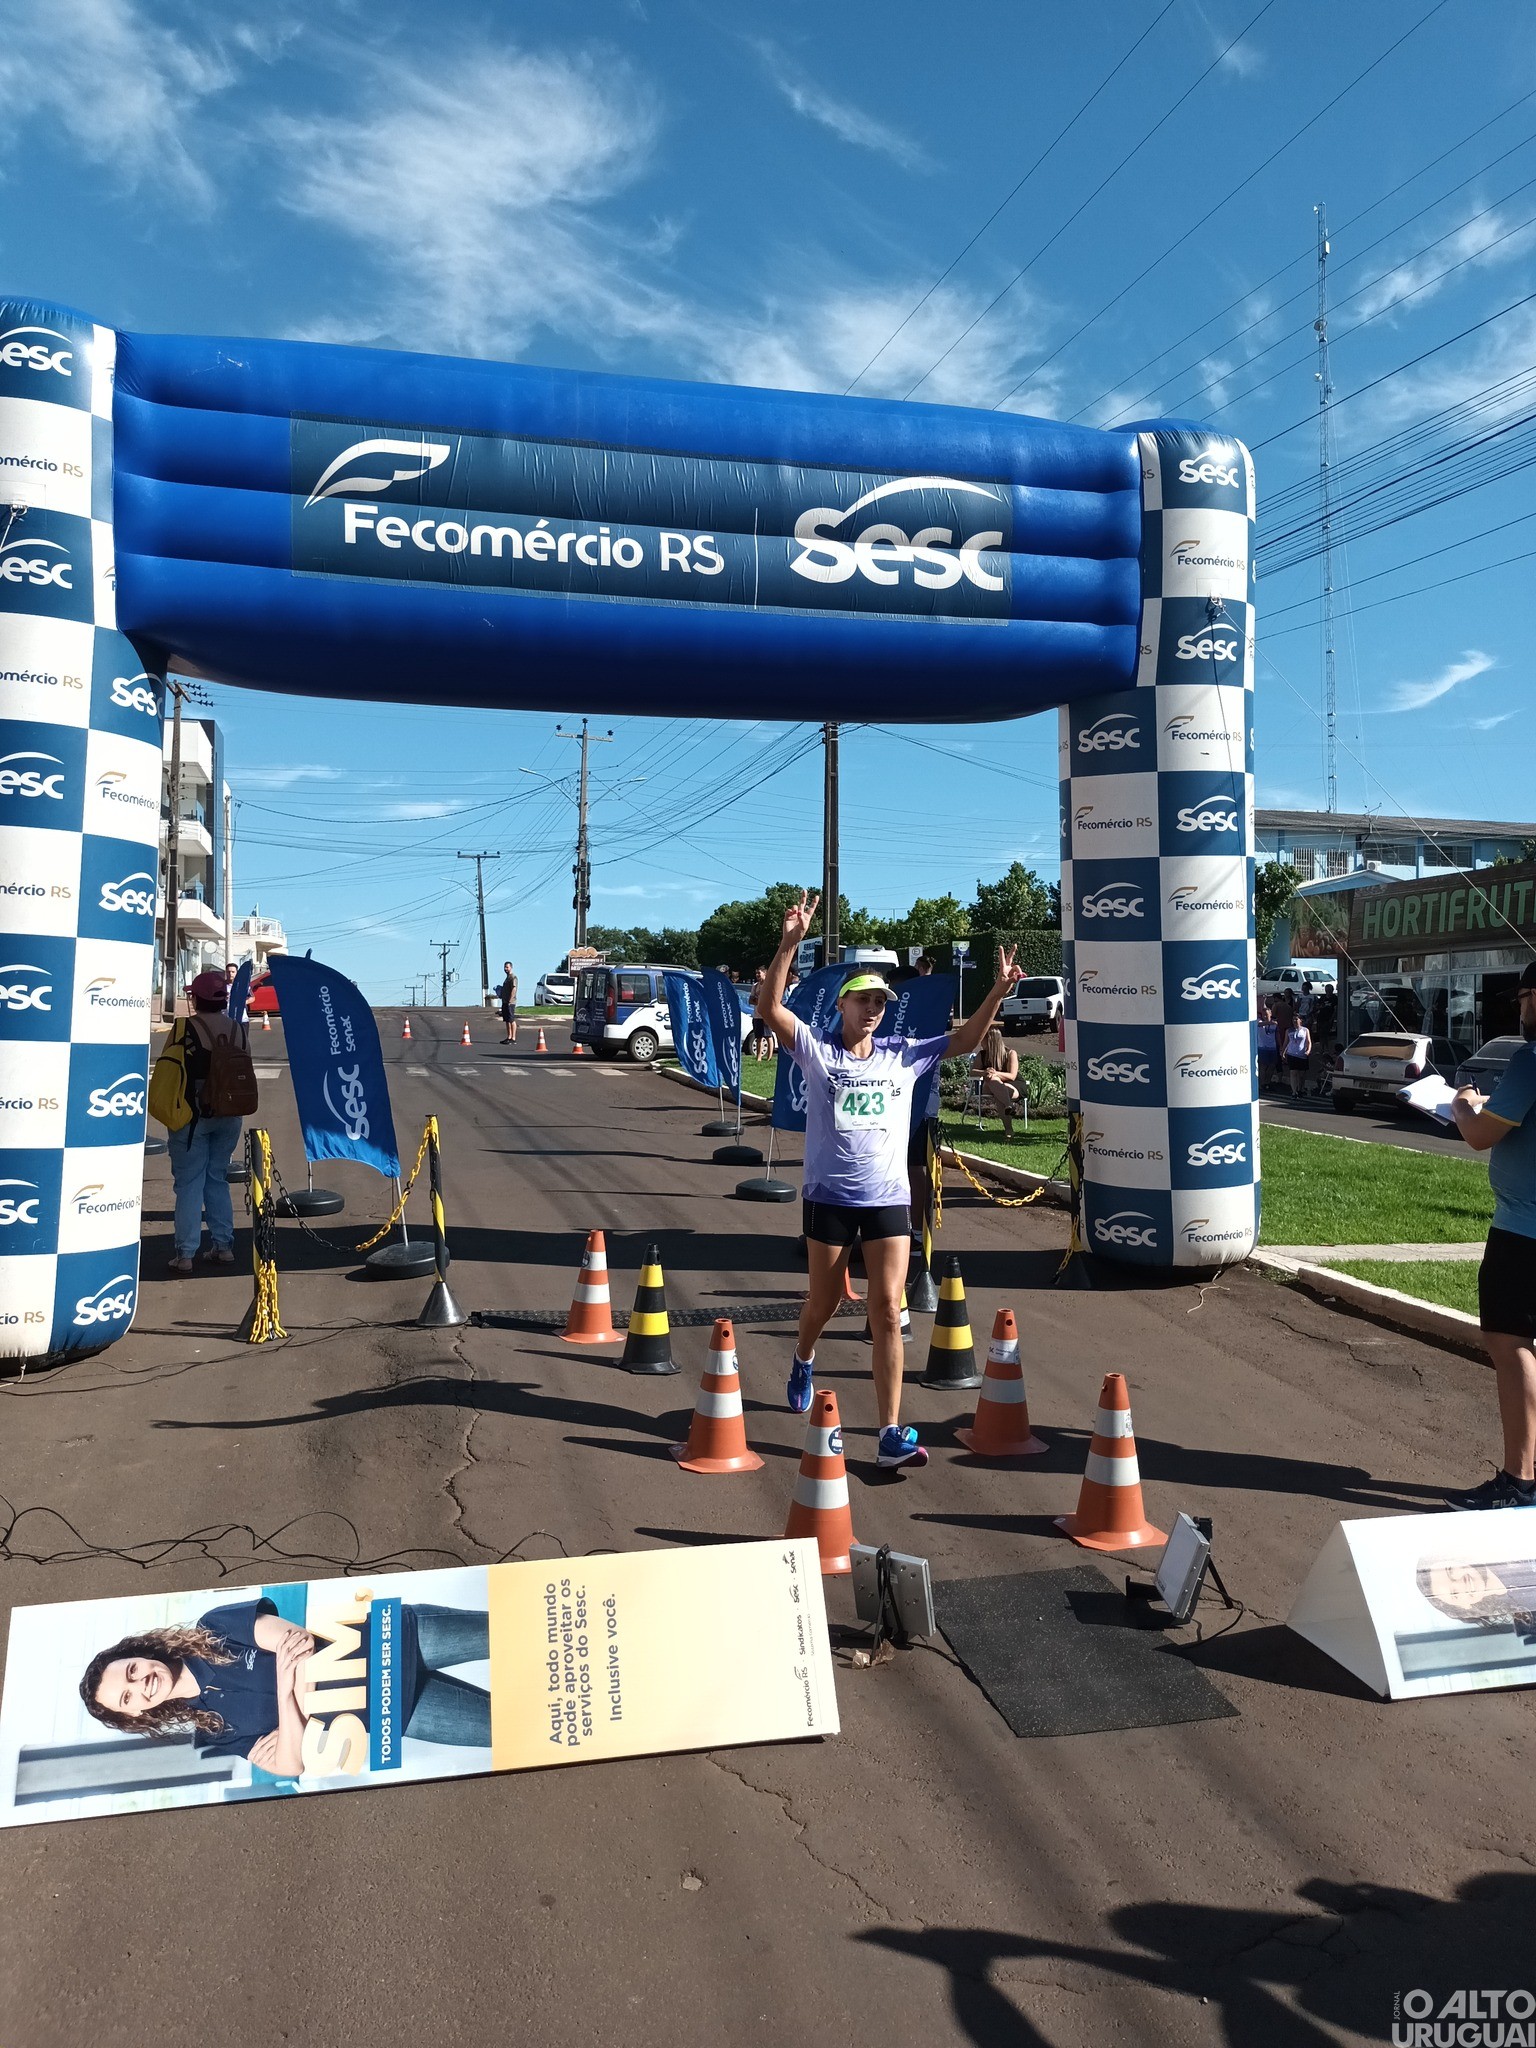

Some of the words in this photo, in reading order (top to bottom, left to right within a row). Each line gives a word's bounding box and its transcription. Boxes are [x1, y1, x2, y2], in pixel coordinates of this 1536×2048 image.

[0, 327, 73, 376] esc
[0, 456, 58, 471] omércio
[62, 463, 84, 477] RS
[1179, 450, 1239, 488] Sesc
[343, 502, 644, 570] Fecomércio
[660, 534, 725, 576] RS
[789, 476, 1004, 592] Sesc
[0, 539, 73, 590] esc
[1177, 555, 1235, 568] Fecomércio
[1236, 560, 1246, 571] RS
[1175, 623, 1238, 662] Sesc
[0, 670, 58, 685] omércio
[63, 676, 84, 689] RS
[1078, 713, 1140, 753] Sesc
[1172, 730, 1231, 740] Fecomércio
[1232, 732, 1242, 741] RS
[0, 752, 65, 799] esc
[102, 787, 155, 809] Fecomércio
[1176, 795, 1238, 832] Sesc
[1078, 819, 1133, 830] Fecomércio
[1136, 817, 1153, 828] RS
[51, 886, 71, 899] RS
[99, 872, 154, 916] Sesc
[1081, 882, 1145, 918] Sesc
[1176, 900, 1234, 911] Fecomércio
[1235, 900, 1244, 910] RS
[1082, 984, 1137, 995] Fecomércio
[1141, 985, 1157, 995] RS
[1181, 963, 1241, 1000] Sesc
[91, 995, 145, 1008] Fecomércio
[655, 1011, 670, 1022] Se
[811, 988, 826, 1028] omércio
[893, 992, 911, 1040] omércio
[320, 985, 341, 1056] Fecomércio
[340, 1015, 356, 1052] Senac
[683, 1029, 708, 1074] Sesc
[1087, 1048, 1150, 1083] Sesc
[1181, 1066, 1237, 1078] Fecomércio
[1239, 1065, 1248, 1075] RS
[38, 1097, 59, 1110] RS
[86, 1073, 145, 1118] Sesc
[322, 1064, 370, 1141] Sesc
[842, 1092, 885, 1116] 423
[1088, 1144, 1144, 1159] Fecomércio
[1147, 1151, 1164, 1160] RS
[1187, 1129, 1246, 1166] Sesc
[78, 1198, 135, 1214] Fecomércio
[1094, 1211, 1157, 1248] Sesc
[1188, 1230, 1243, 1243] Fecomércio
[1244, 1227, 1253, 1236] RS
[24, 1311, 45, 1324] RS
[73, 1274, 134, 1326] Sesc
[1492, 1497, 1518, 1509] FILA
[560, 1578, 571, 1598] os
[574, 1584, 587, 1629] Sesc.
[381, 1604, 392, 1640] SESC.
[543, 1583, 558, 1644] mundo
[602, 1593, 617, 1640] você.
[561, 1602, 578, 1693] aproveitar
[575, 1635, 589, 1658] do
[797, 1614, 806, 1656] Sindicatos
[381, 1643, 392, 1667] SER
[546, 1649, 560, 1692] todo
[801, 1667, 808, 1678] RS
[381, 1668, 392, 1715] PODEM
[577, 1664, 593, 1736] serviços
[605, 1644, 622, 1721] Inclusive
[548, 1697, 563, 1744] Aqui,
[802, 1679, 814, 1727] Fecomércio
[381, 1717, 392, 1764] TODOS
[564, 1699, 581, 1746] pode
